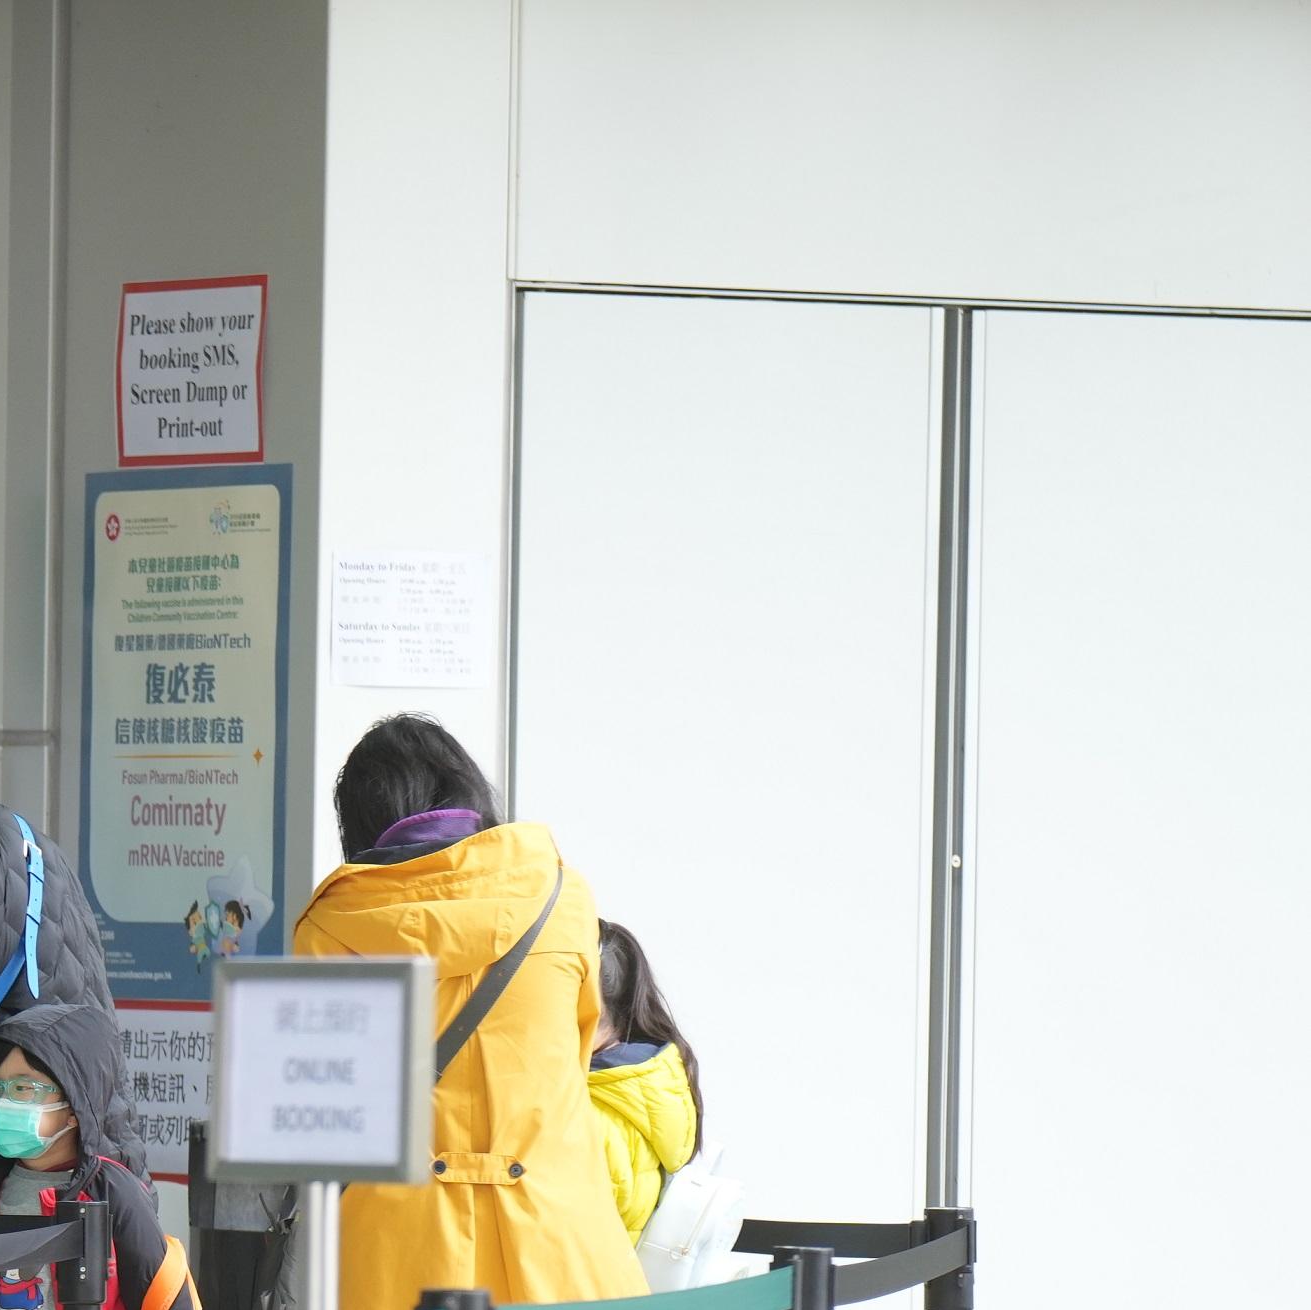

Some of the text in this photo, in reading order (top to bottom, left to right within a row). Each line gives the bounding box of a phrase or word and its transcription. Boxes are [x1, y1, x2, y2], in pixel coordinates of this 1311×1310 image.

[129, 312, 255, 336] Please show your
[139, 347, 200, 373] booking
[130, 381, 248, 407] Screen Dump or
[157, 416, 223, 439] Print-out
[339, 561, 374, 572] Monday
[378, 562, 387, 571] to
[122, 599, 133, 609] The
[134, 599, 161, 611] following
[338, 621, 378, 632] Saturday
[382, 622, 389, 632] to
[146, 662, 215, 704] 復必泰
[115, 717, 244, 745] 信使核糖核酸疫苗
[122, 769, 239, 785] Fosun Pharma/BioNTech
[130, 795, 227, 836] Comirnaty
[128, 844, 225, 868] mRNA Vaccine
[282, 1056, 356, 1085] ONLINE
[126, 1071, 212, 1105] 機短訊、
[272, 1104, 366, 1133] BOOKING
